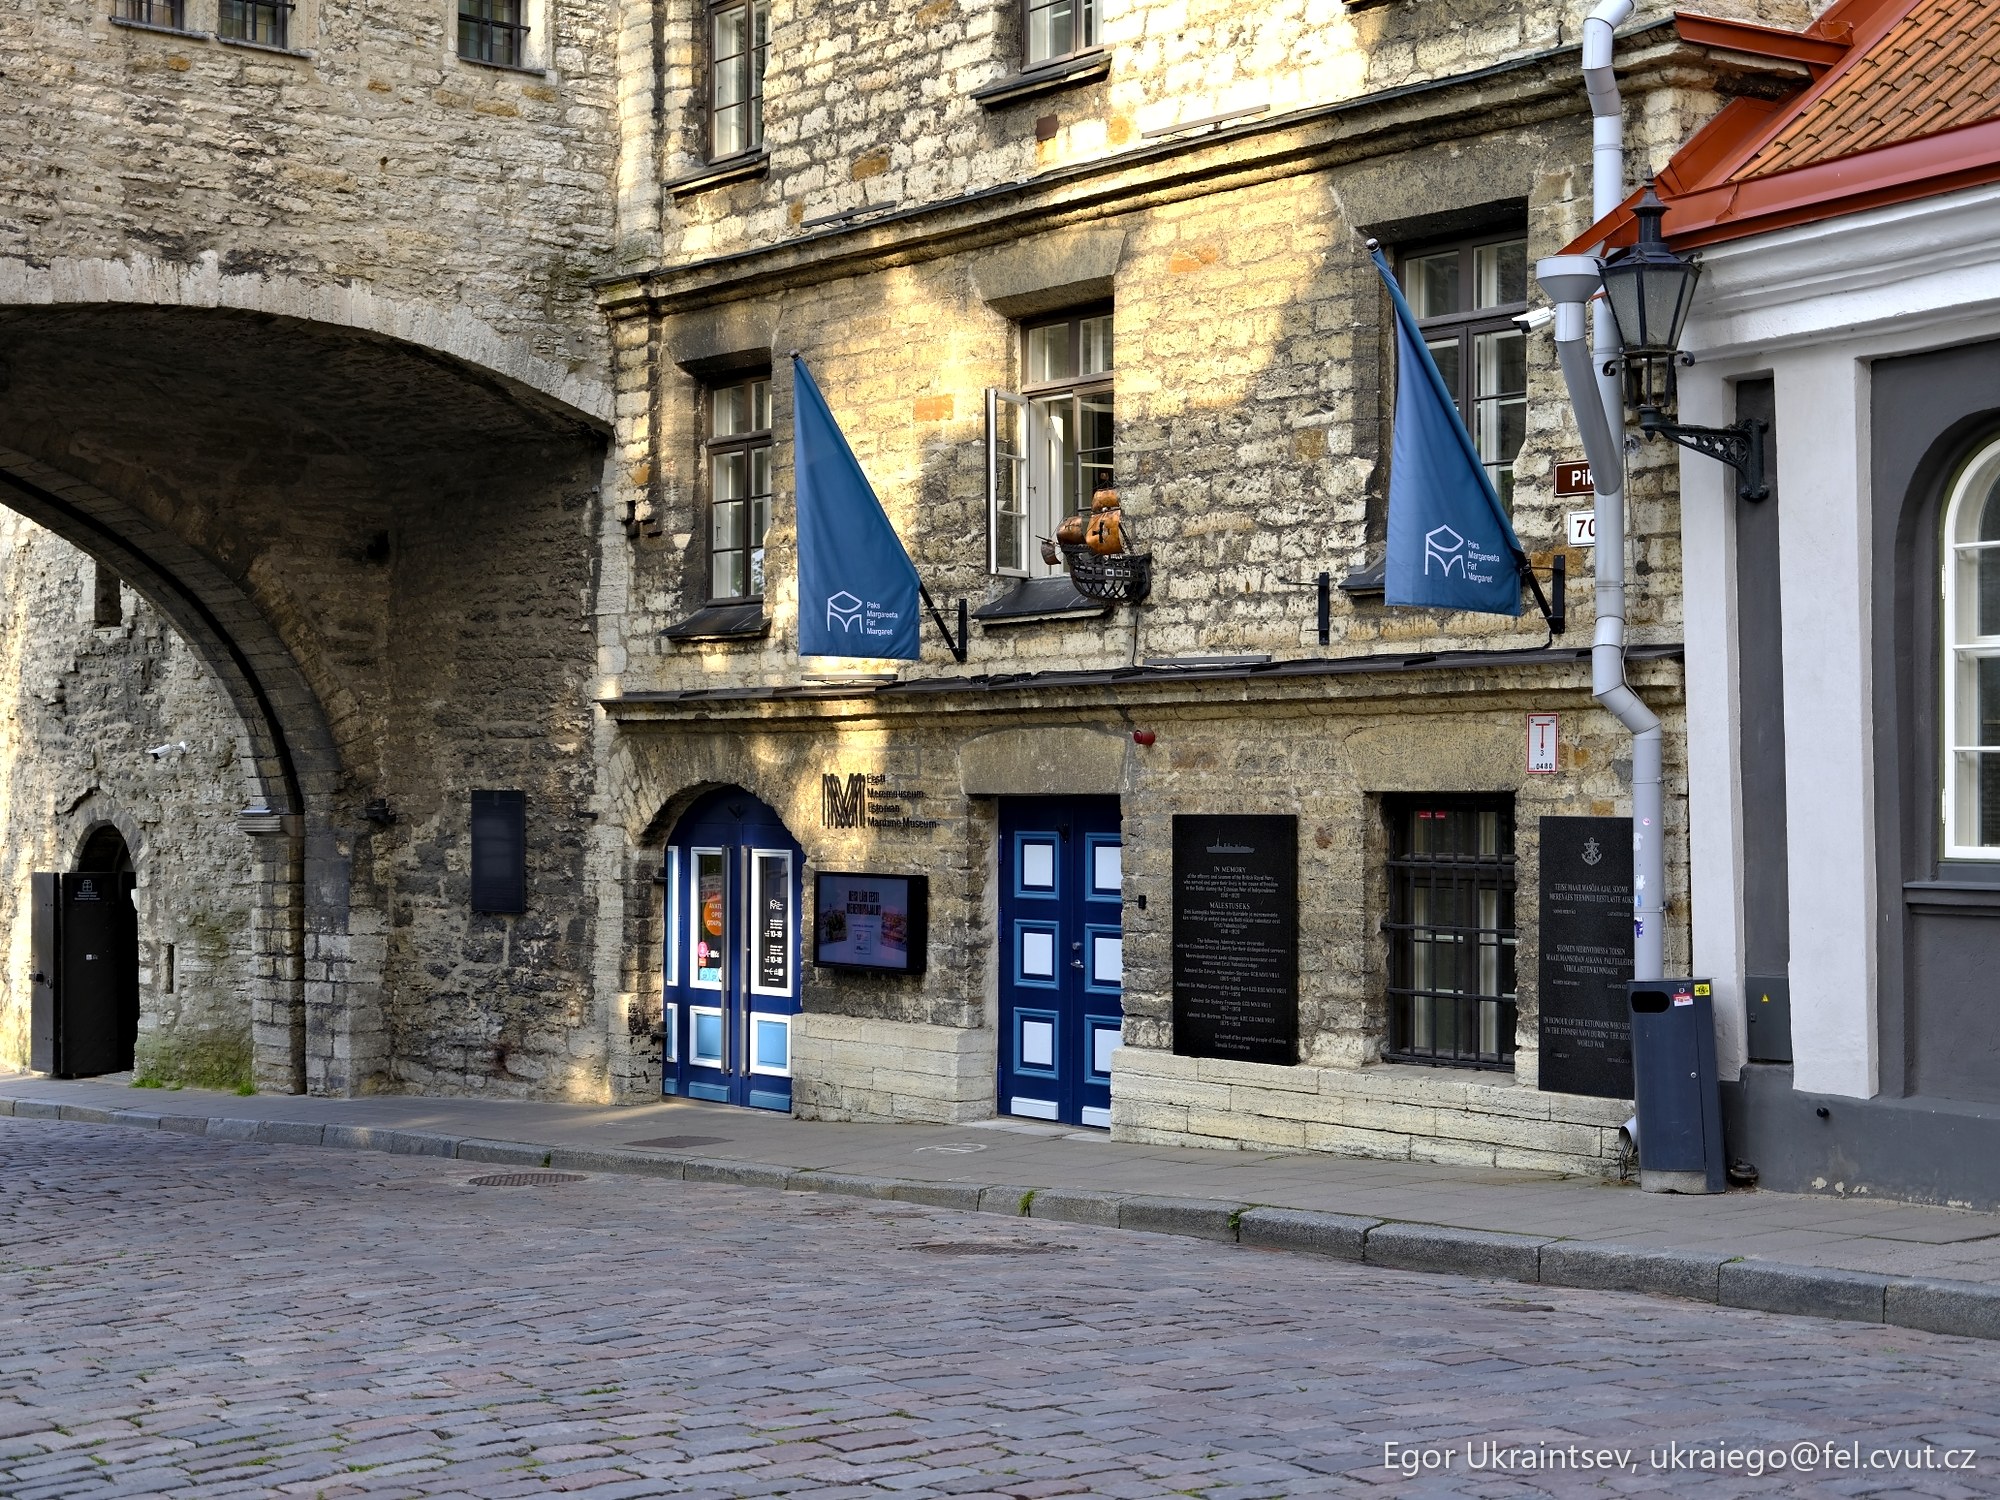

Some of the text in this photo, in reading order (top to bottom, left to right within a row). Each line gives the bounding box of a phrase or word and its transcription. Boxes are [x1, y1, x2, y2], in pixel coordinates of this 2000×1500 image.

[1468, 550, 1500, 562] Margareeta
[1467, 561, 1477, 571] Fat
[1468, 572, 1493, 583] Margaret
[866, 601, 881, 609] Paks
[866, 610, 898, 619] Margareeta
[866, 627, 893, 636] Margaret
[866, 773, 886, 784] Eesti
[902, 817, 937, 829] Museum
